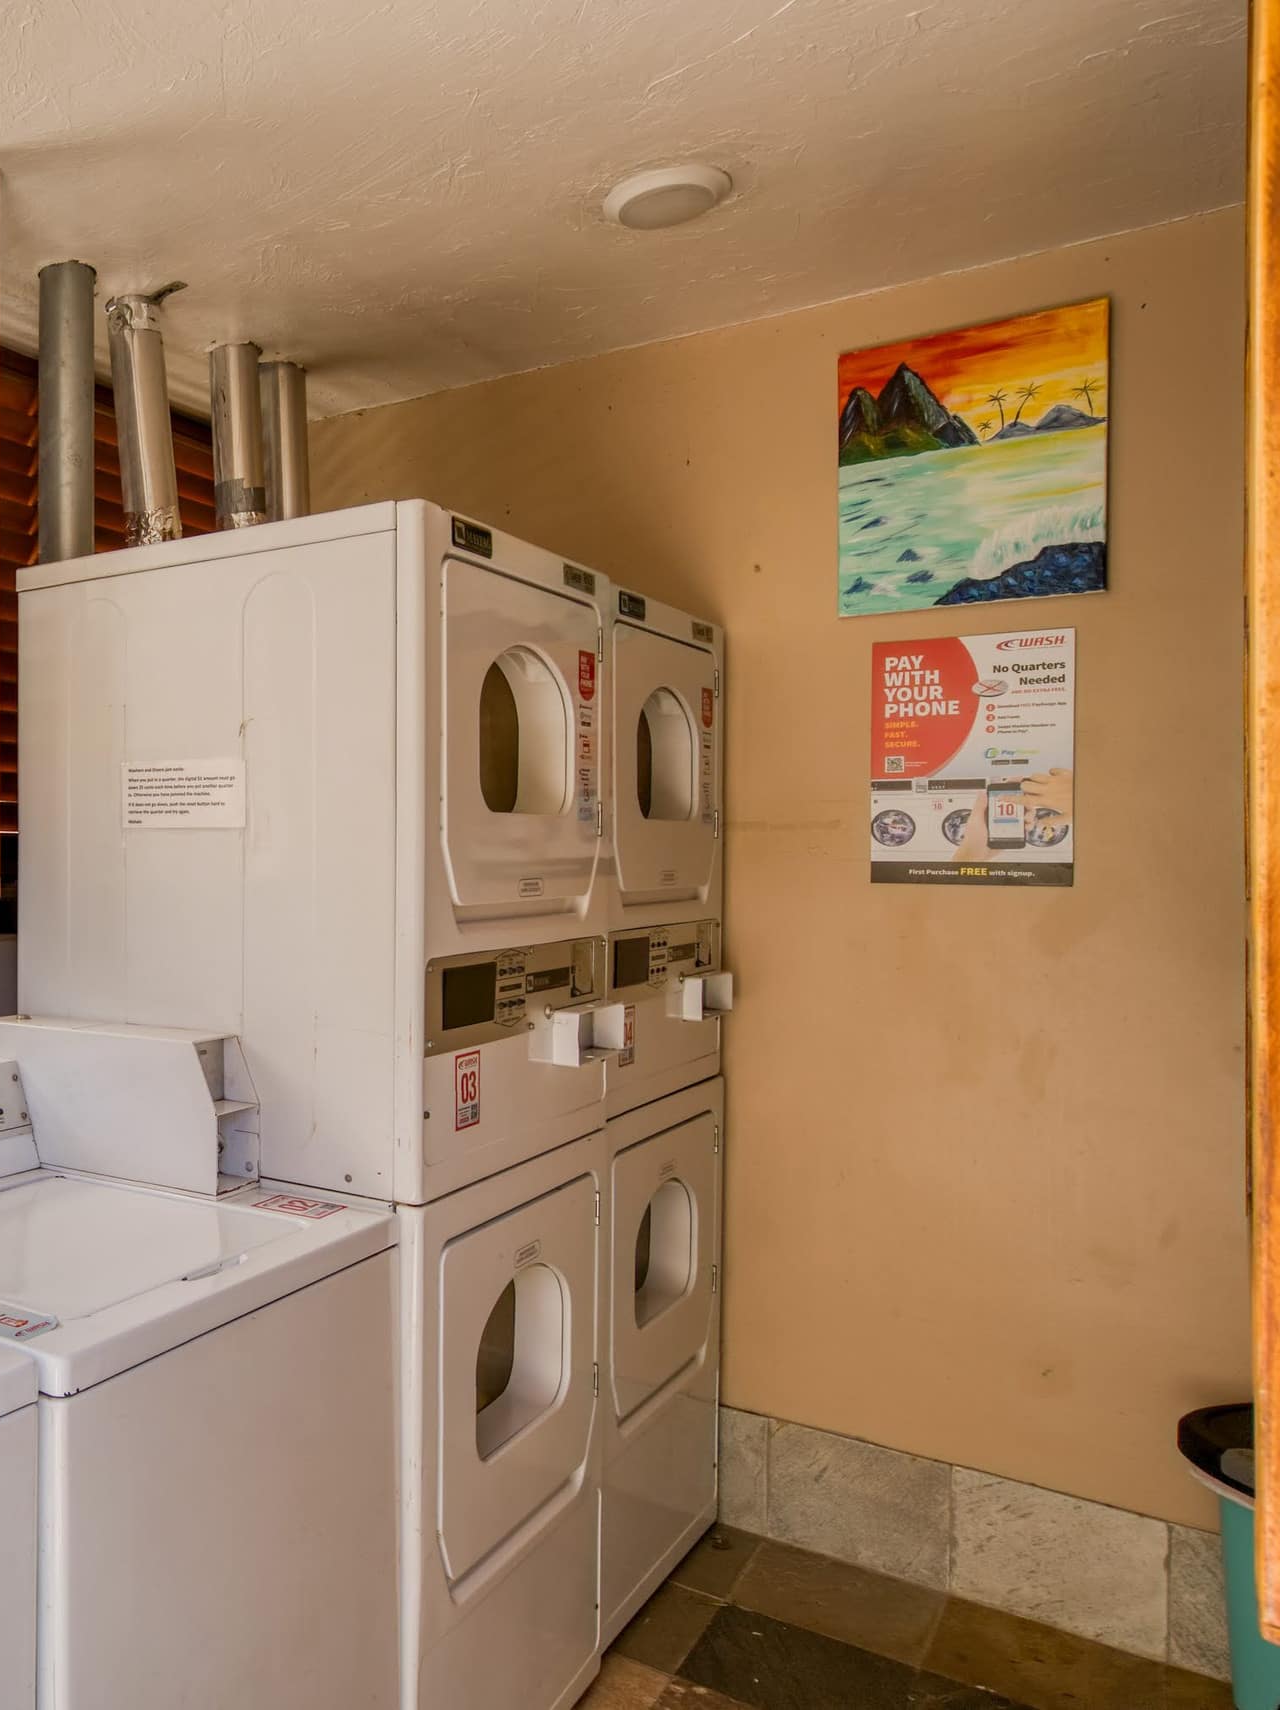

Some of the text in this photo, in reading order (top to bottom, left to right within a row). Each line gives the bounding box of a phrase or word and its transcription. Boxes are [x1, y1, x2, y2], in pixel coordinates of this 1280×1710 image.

[1019, 635, 1065, 648] WASH
[885, 655, 924, 672] PAY
[993, 661, 1066, 674] No Quarters
[884, 669, 940, 687] WITH
[1019, 674, 1066, 685] Needed
[884, 685, 944, 702] YOUR
[884, 700, 960, 718] PHONE
[884, 720, 919, 729] SIMPLE.
[884, 730, 908, 739] FAST.
[884, 740, 921, 748] SECURE.
[998, 803, 1015, 816] 10
[909, 867, 1035, 879] First Purchase FREE with signup.
[461, 1071, 477, 1104] 03
